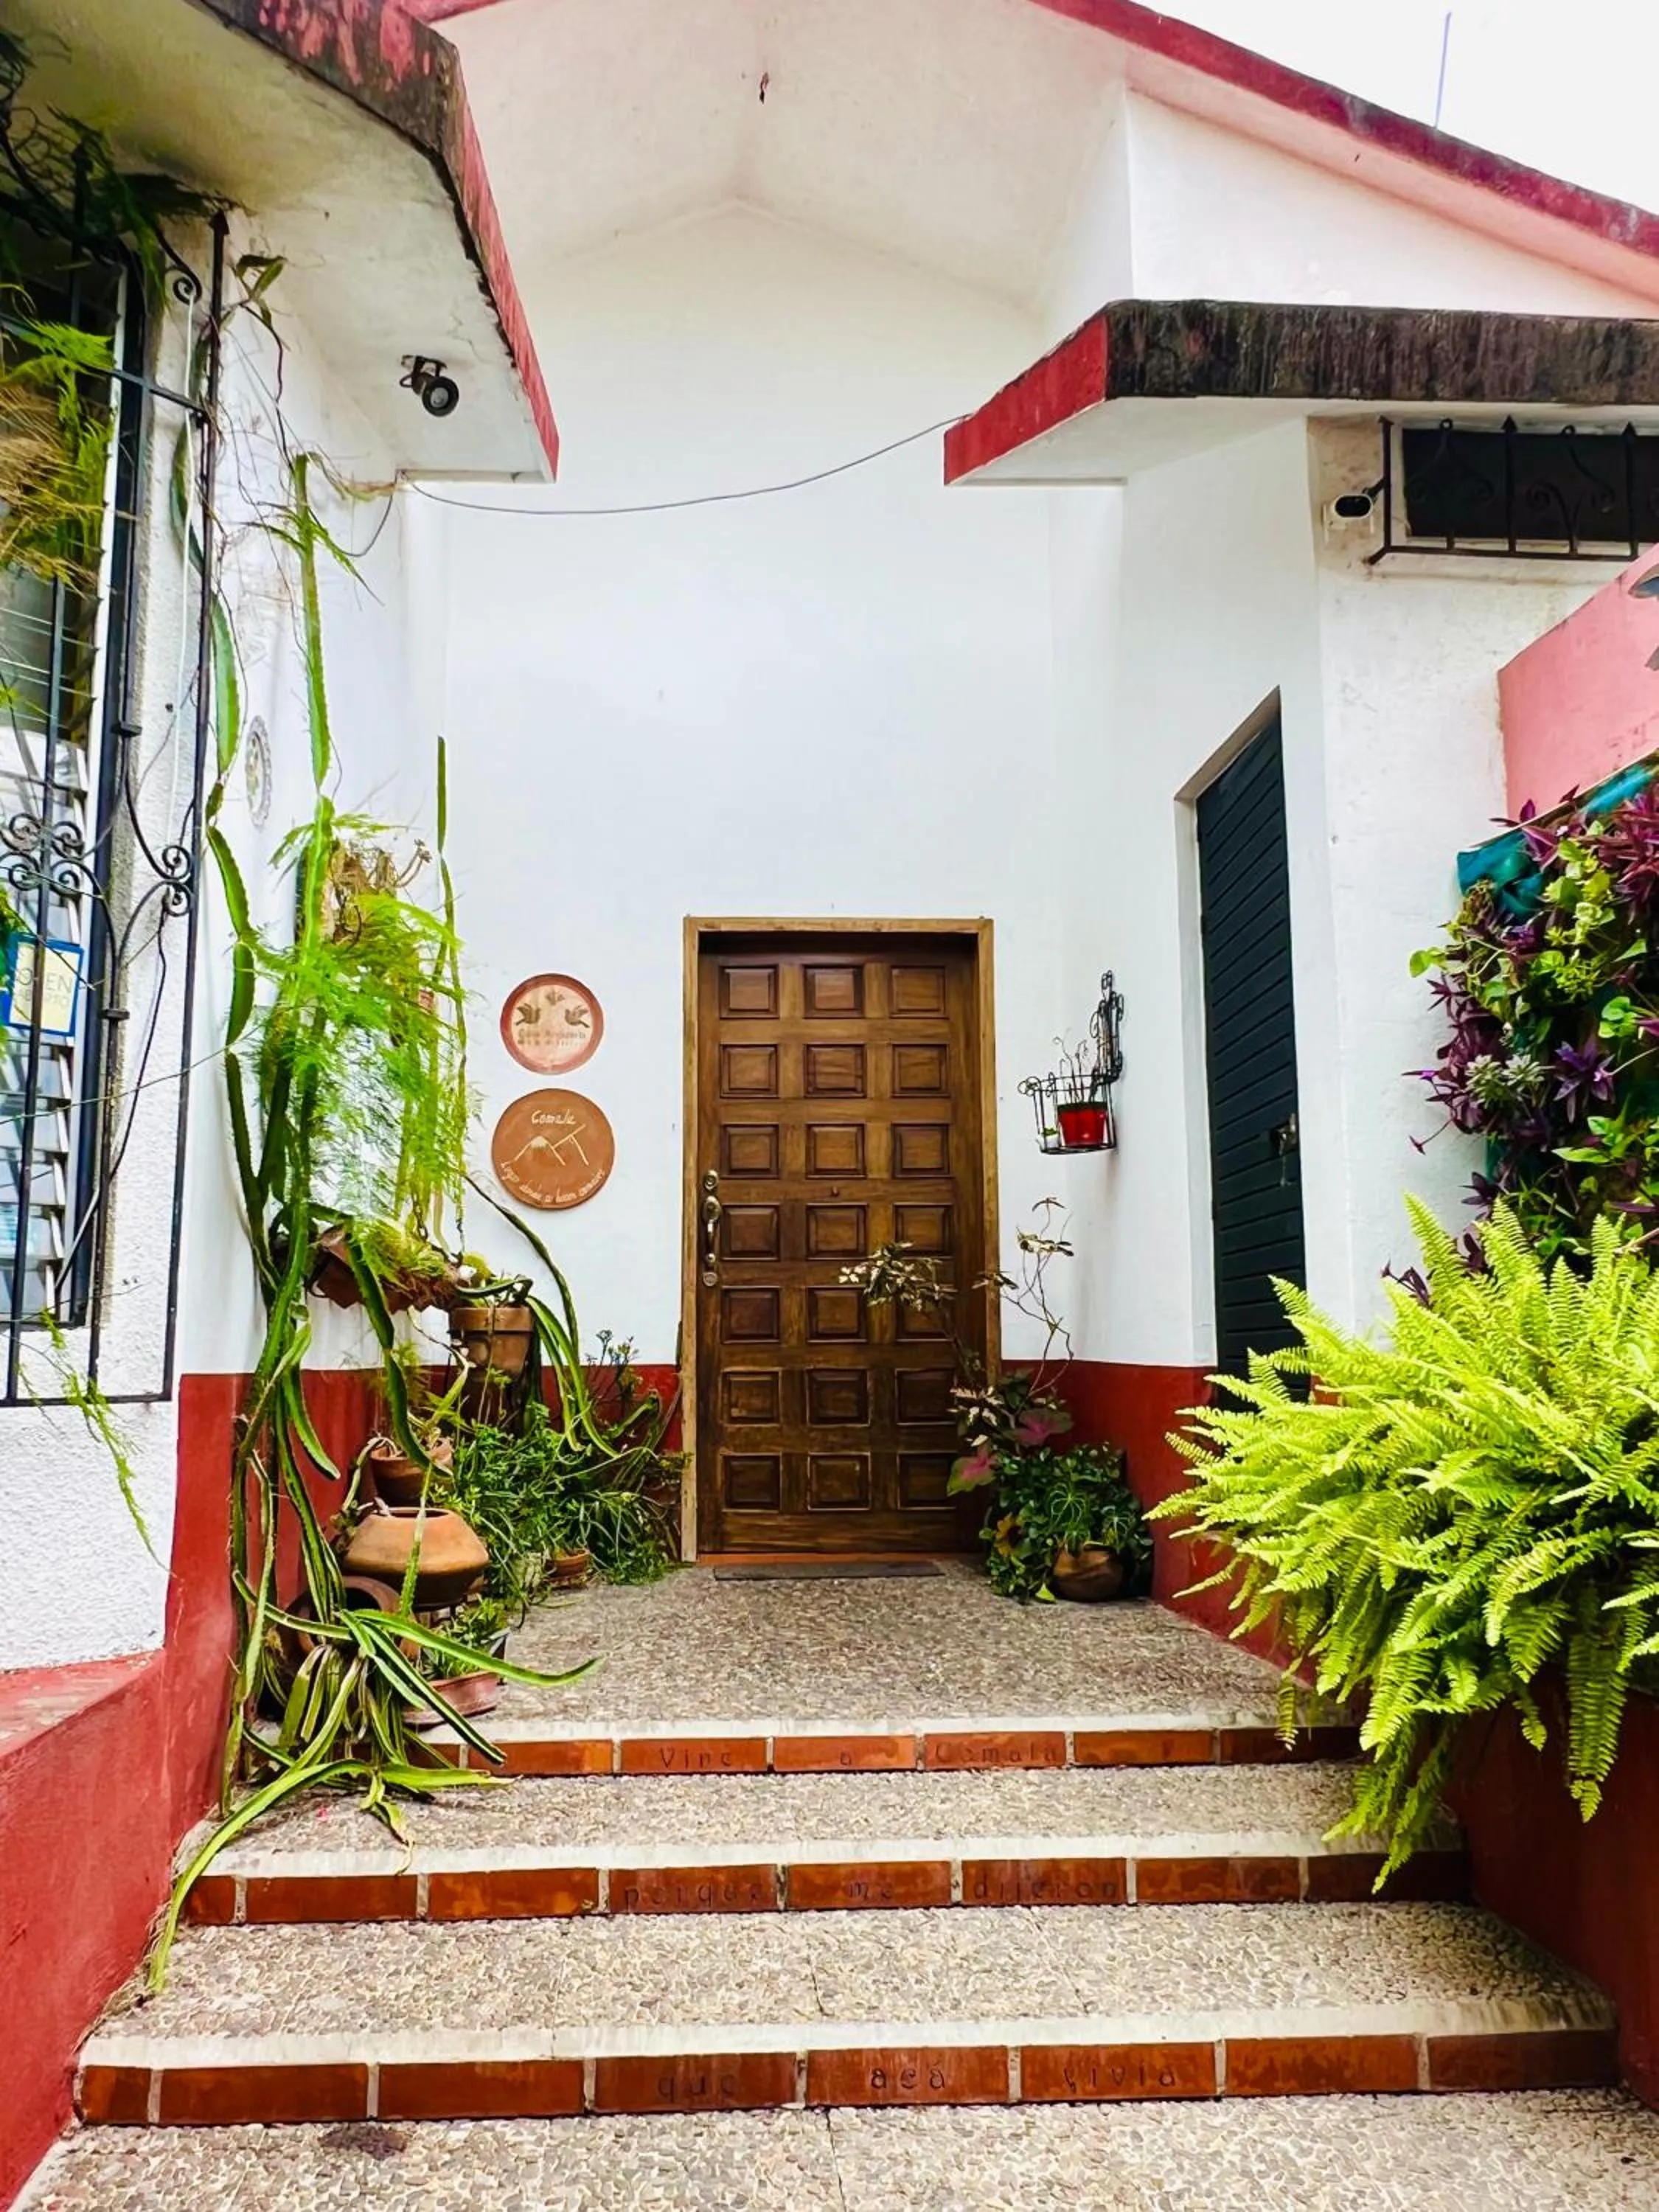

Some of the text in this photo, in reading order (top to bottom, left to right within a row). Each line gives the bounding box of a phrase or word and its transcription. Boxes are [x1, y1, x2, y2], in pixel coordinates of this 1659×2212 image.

[17, 967, 73, 993] OEN
[659, 1747, 732, 1769] Vine
[935, 1740, 1057, 1763] Comala
